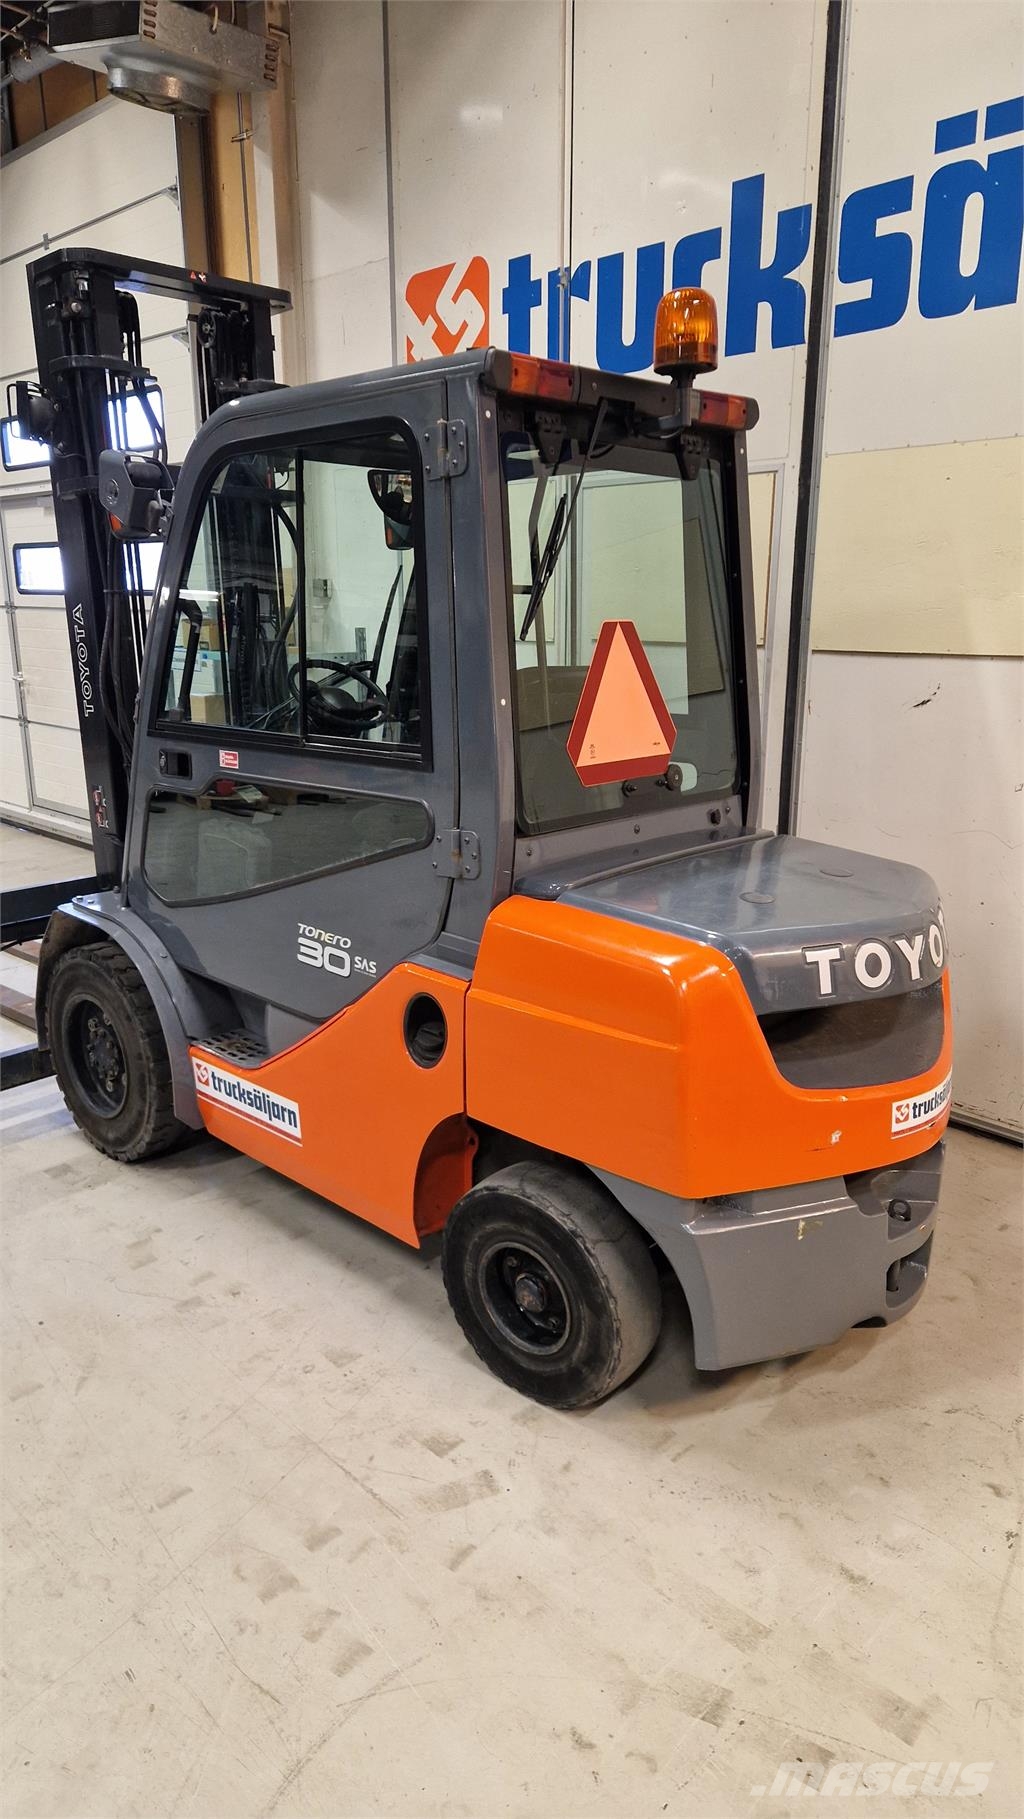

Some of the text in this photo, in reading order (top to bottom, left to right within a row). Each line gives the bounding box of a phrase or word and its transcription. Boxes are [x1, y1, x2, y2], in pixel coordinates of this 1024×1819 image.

[73, 603, 94, 717] TOYOTA
[297, 937, 377, 977] 30 SAS
[211, 1071, 298, 1129] trucksäljarn
